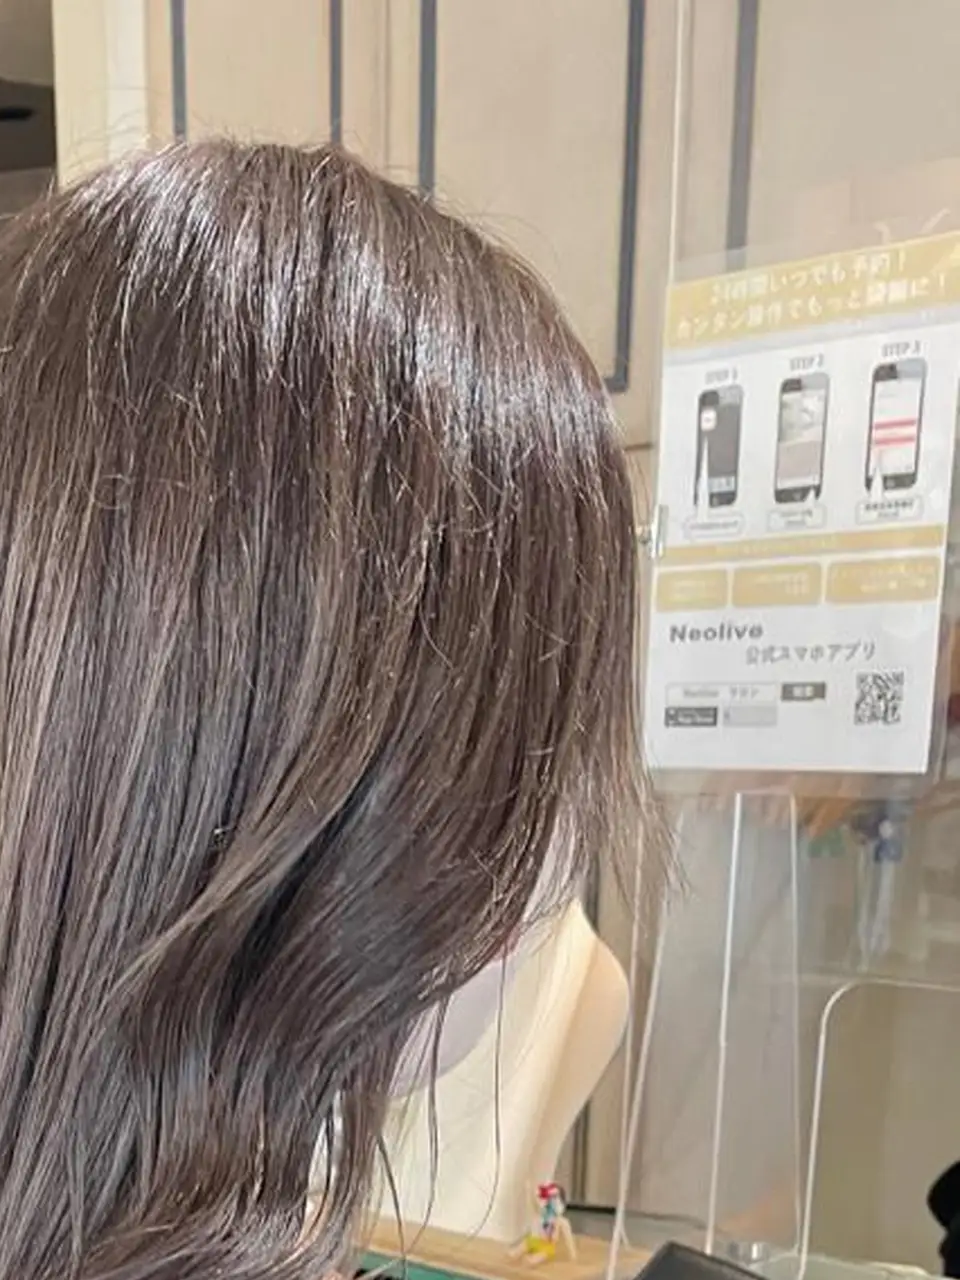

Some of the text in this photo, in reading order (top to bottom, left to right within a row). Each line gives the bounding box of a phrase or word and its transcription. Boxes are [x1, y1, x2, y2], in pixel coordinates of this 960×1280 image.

[883, 342, 910, 357] STEP
[790, 356, 815, 371] STEP
[669, 622, 764, 643] Neolive
